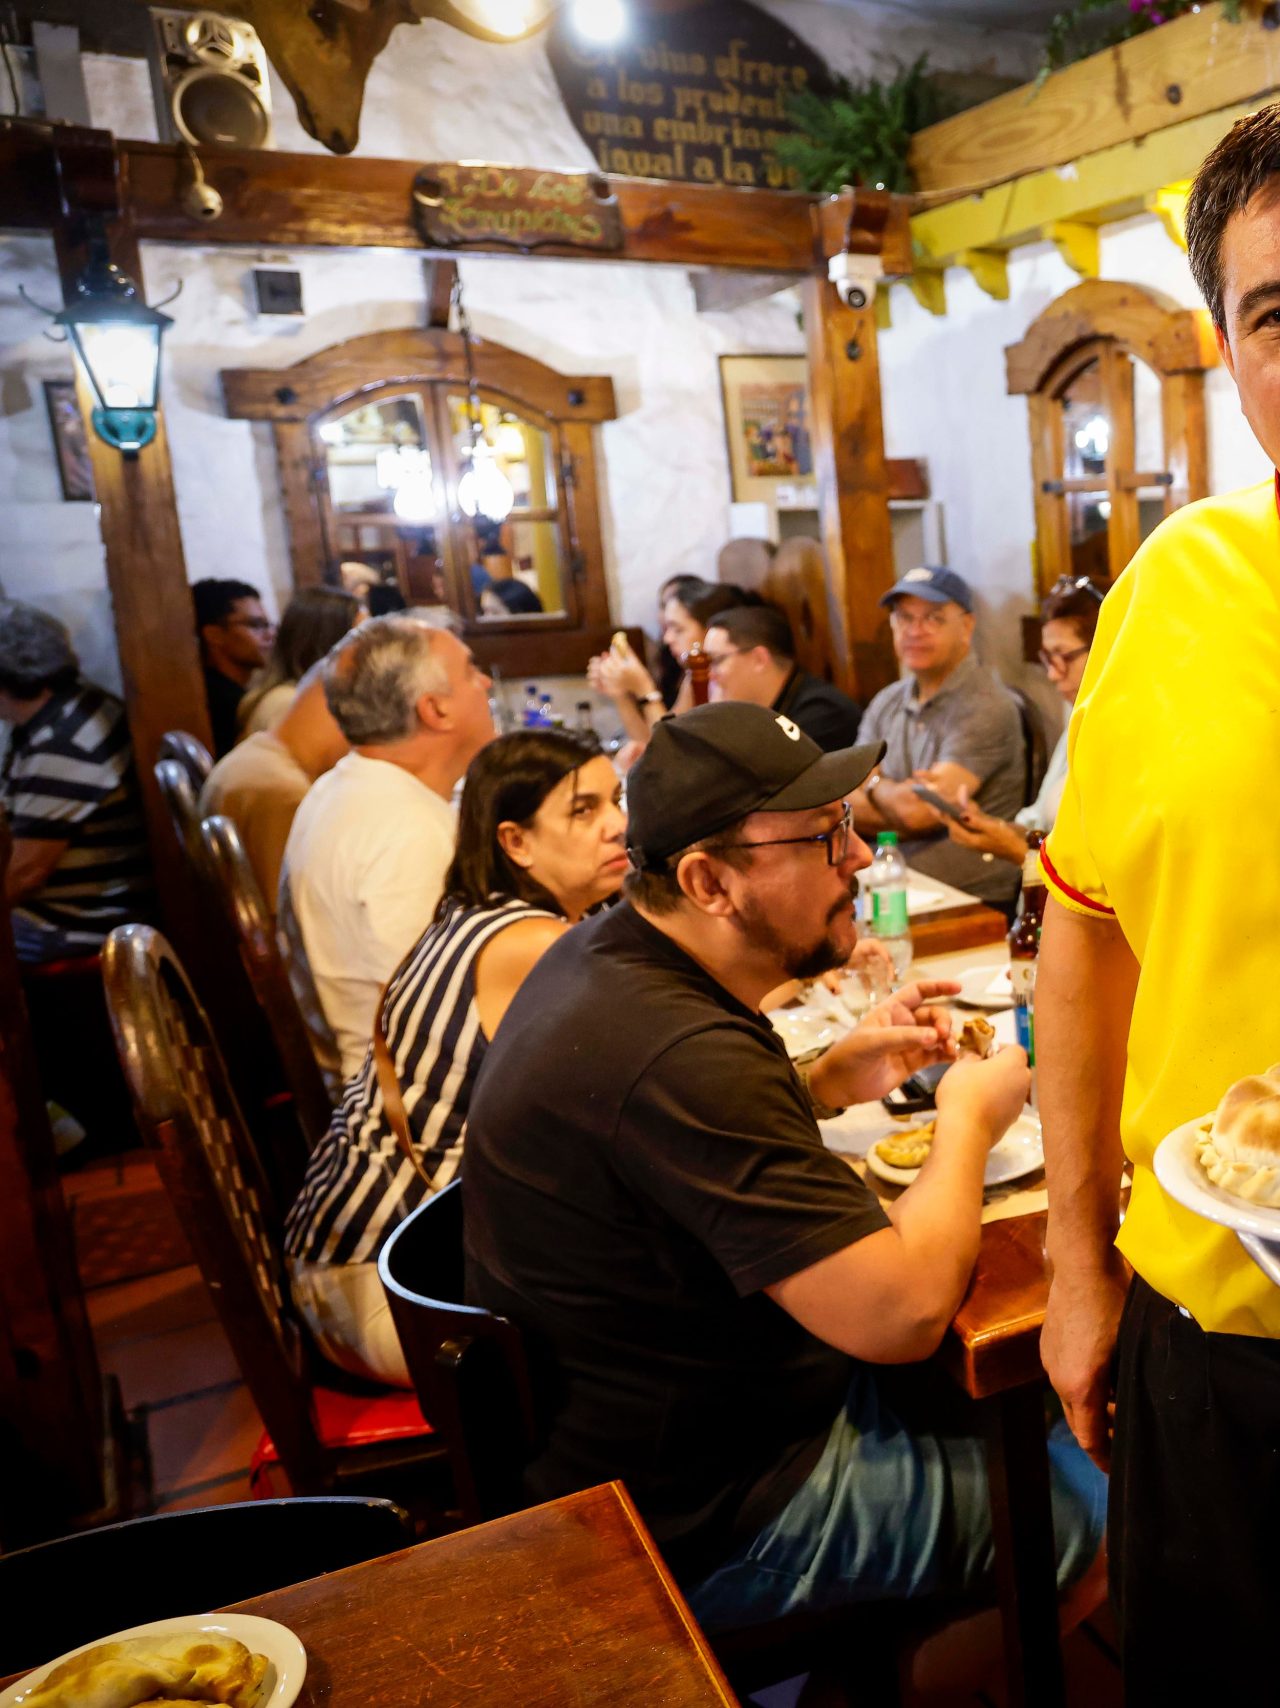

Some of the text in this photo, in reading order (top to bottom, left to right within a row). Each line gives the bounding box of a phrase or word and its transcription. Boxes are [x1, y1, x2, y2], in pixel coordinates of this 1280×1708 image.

[586, 68, 787, 119] a los prudent
[583, 109, 644, 139] una
[721, 145, 756, 184] la
